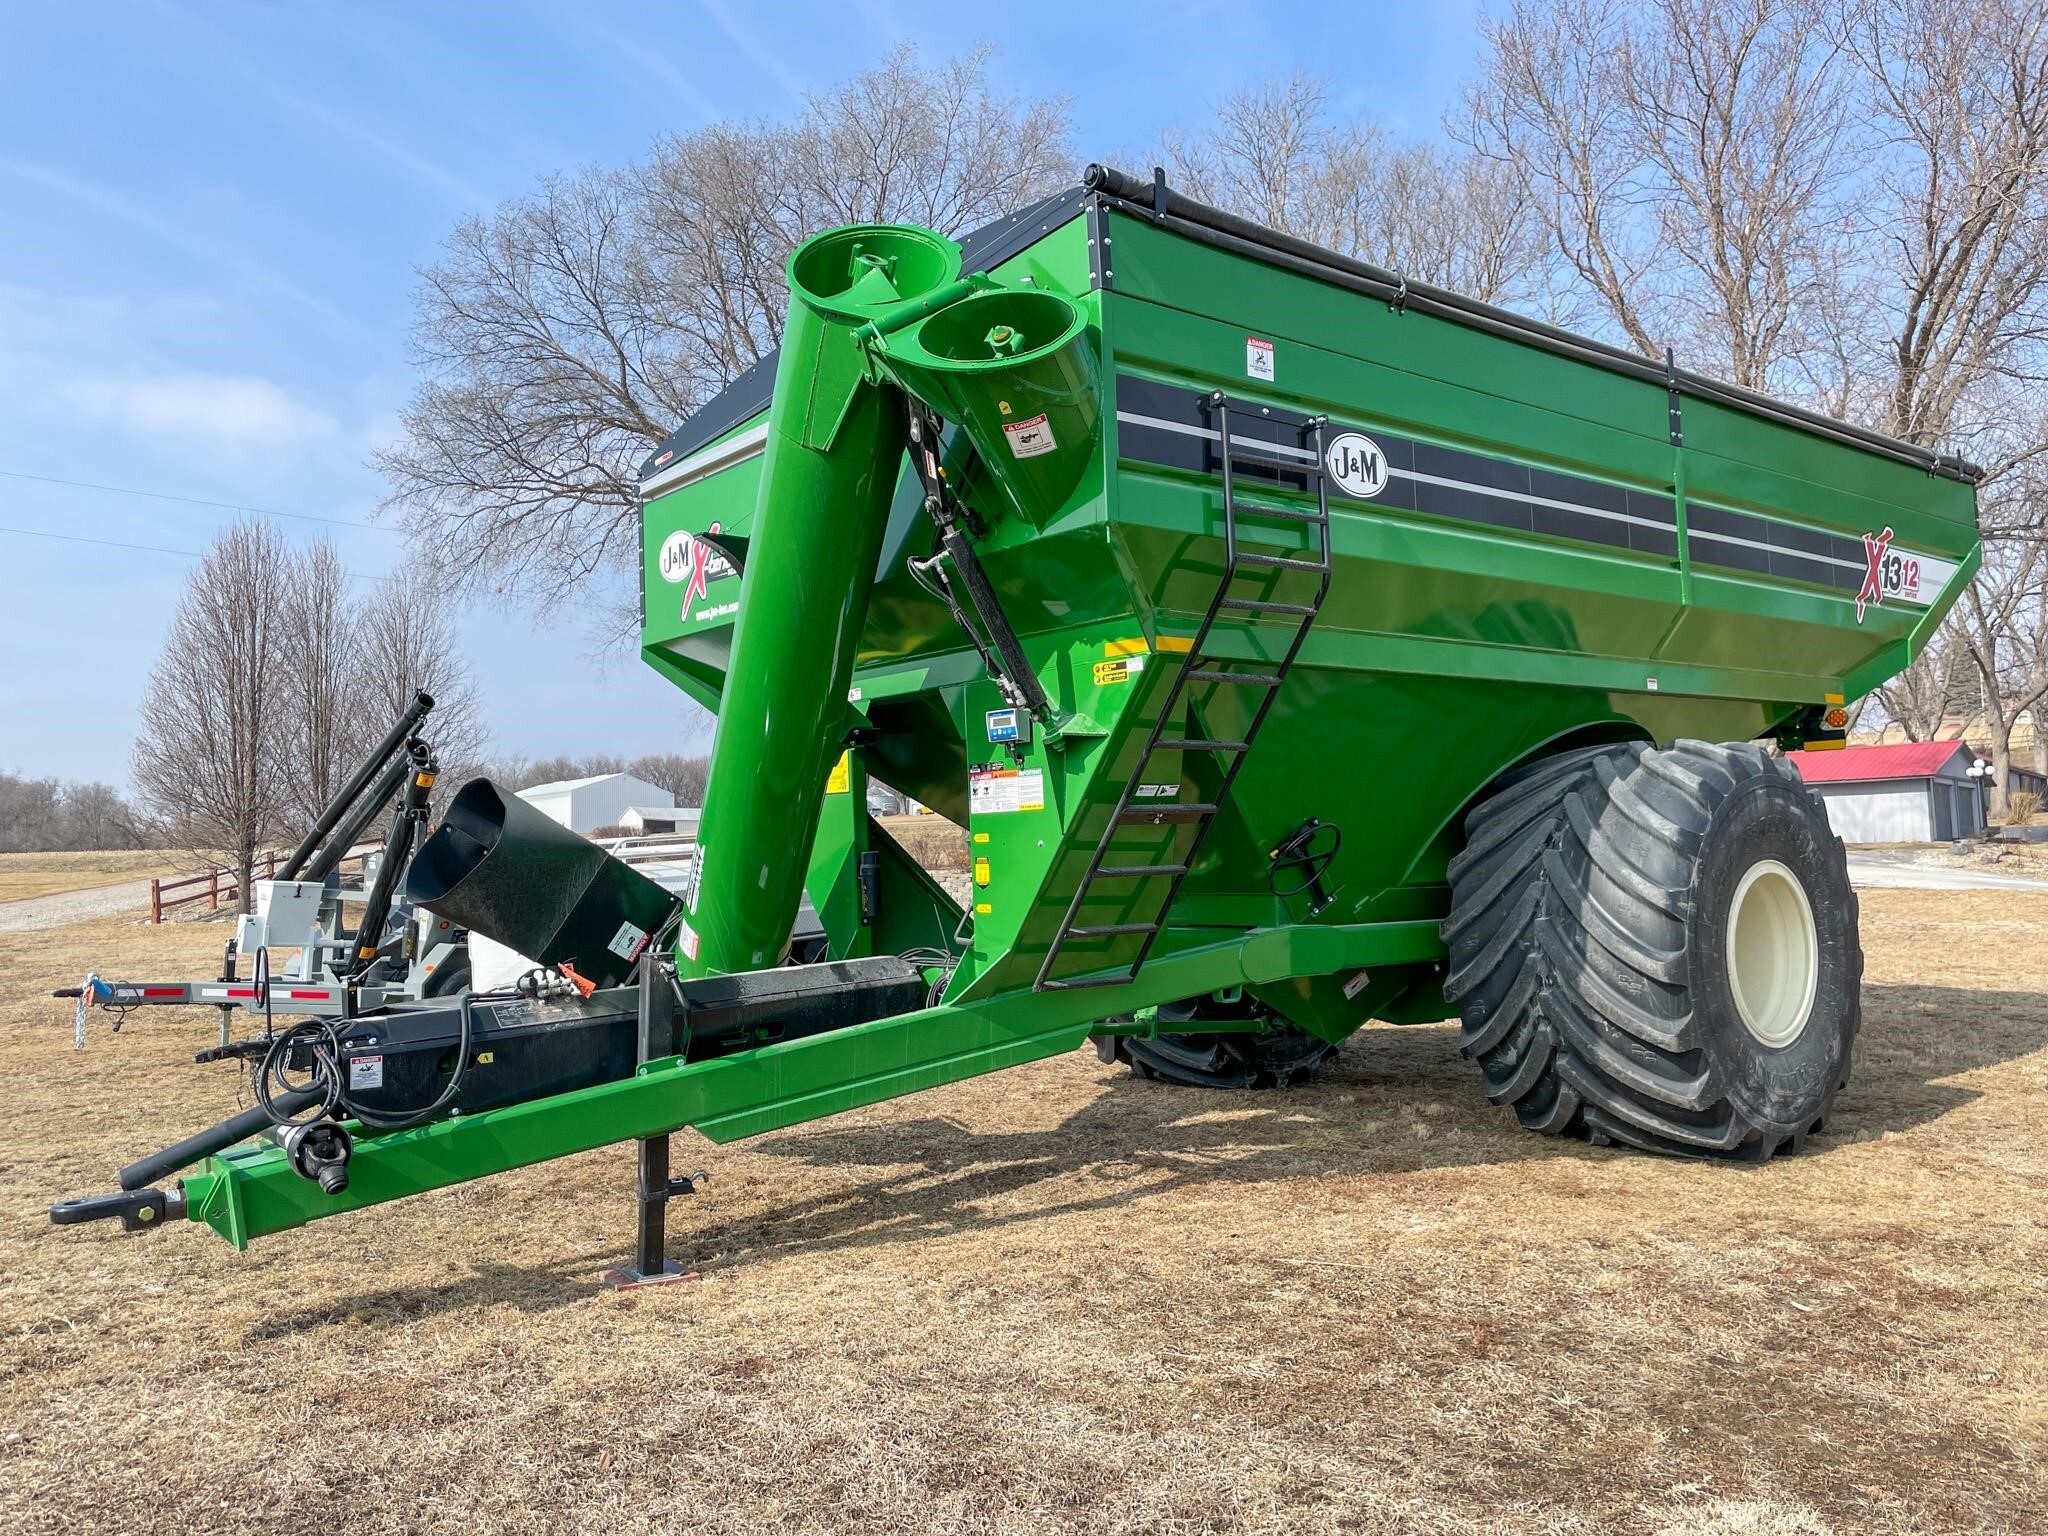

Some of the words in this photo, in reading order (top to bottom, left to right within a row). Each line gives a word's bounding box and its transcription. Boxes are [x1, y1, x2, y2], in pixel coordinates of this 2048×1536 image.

[1014, 417, 1043, 430] DANGER
[1334, 445, 1379, 486] J&M
[664, 540, 689, 573] J&M
